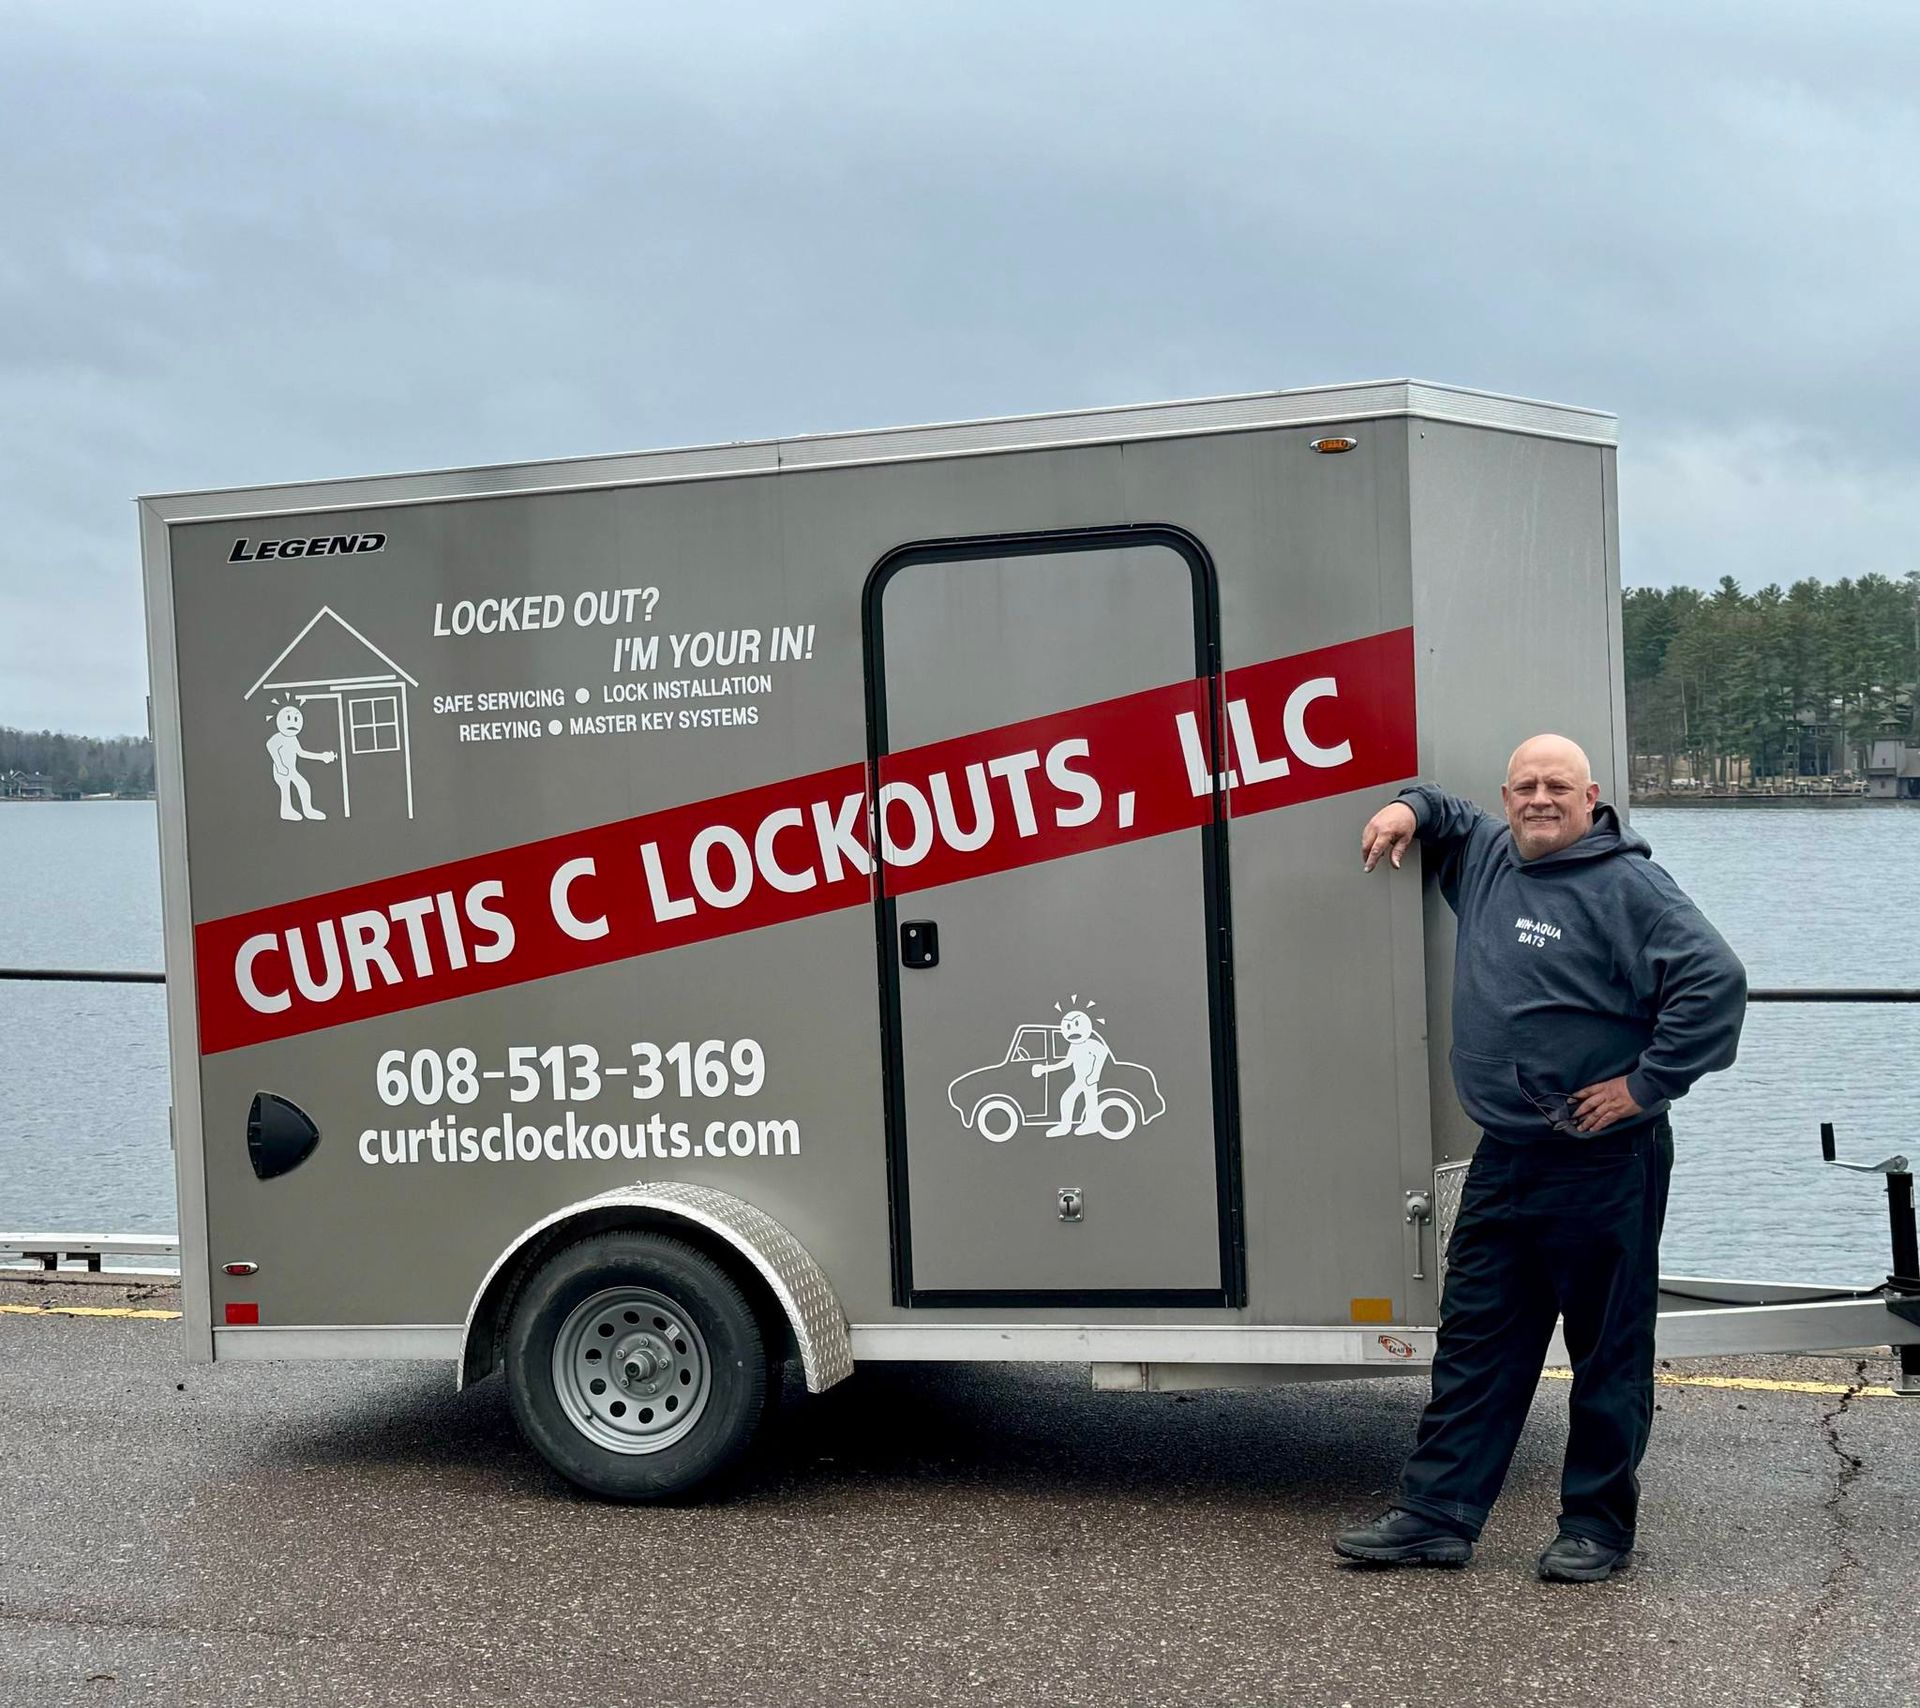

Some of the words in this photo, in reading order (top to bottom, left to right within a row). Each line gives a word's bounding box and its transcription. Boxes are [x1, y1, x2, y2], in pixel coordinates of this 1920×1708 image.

[227, 532, 387, 563] LEGEND
[434, 594, 565, 637] LOCKED
[573, 587, 660, 627] OUT?
[612, 636, 660, 673] I'M
[669, 629, 762, 669] YOUR
[769, 624, 816, 662] IN!
[433, 693, 474, 714] SAFE
[477, 688, 565, 712] SERVICING
[603, 682, 649, 703] LOCK
[652, 675, 772, 700] INSTALLATION
[459, 719, 542, 742] REKEYING
[569, 712, 638, 736] MASTER
[641, 711, 675, 731] KEY
[678, 706, 759, 729] SYSTEMS
[234, 880, 516, 1014] CURTIS
[550, 856, 611, 941] C
[640, 738, 1136, 923] LOCKOUTS,
[1175, 677, 1353, 798] LLC
[1517, 931, 1546, 948] BATS
[376, 1038, 766, 1106] 608-513-3169
[358, 1112, 801, 1165] curtisclockouts.com
